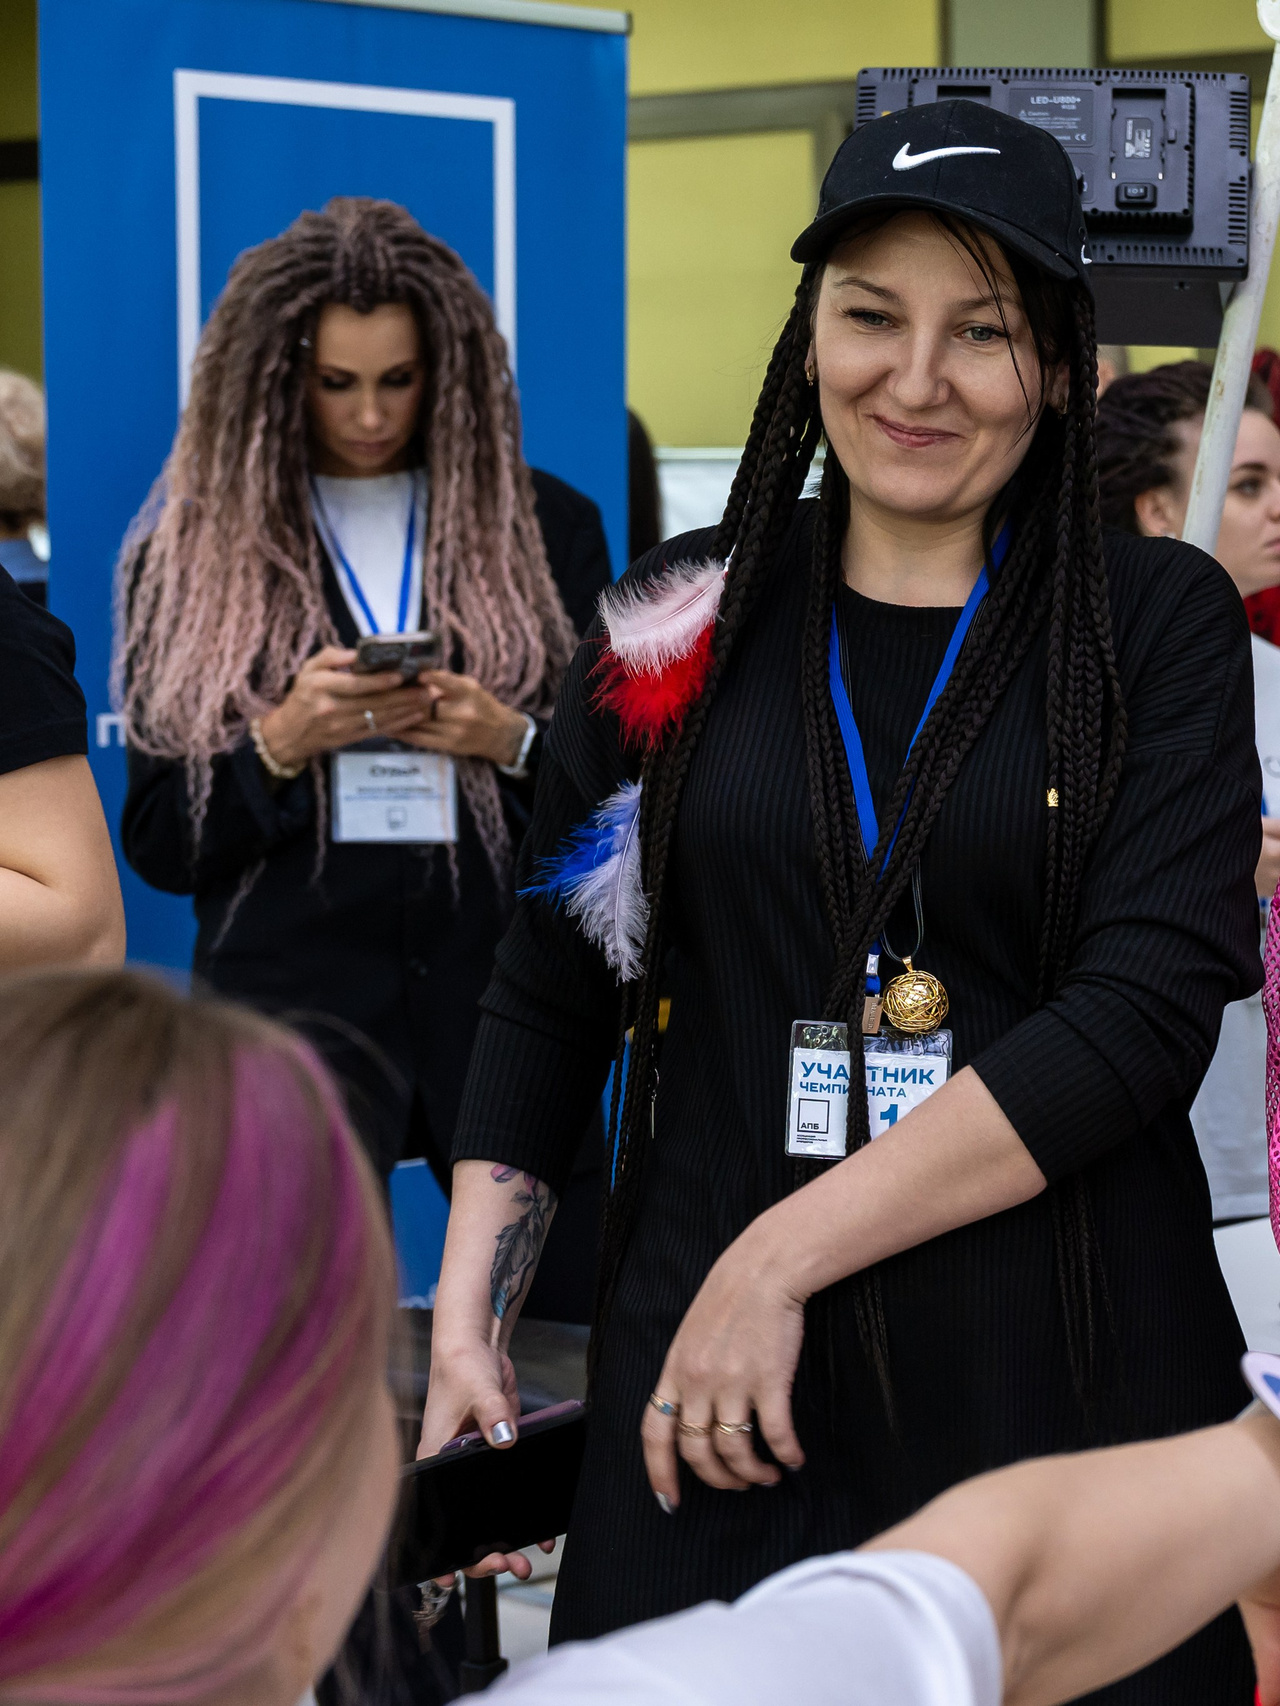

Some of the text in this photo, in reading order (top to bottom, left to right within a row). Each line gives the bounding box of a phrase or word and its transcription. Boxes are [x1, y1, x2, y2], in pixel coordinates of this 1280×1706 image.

[800, 1061, 935, 1085] УЧАТНИК
[799, 1081, 907, 1098] ЧЕМПИНАТА
[800, 1122, 820, 1130] АПБ
